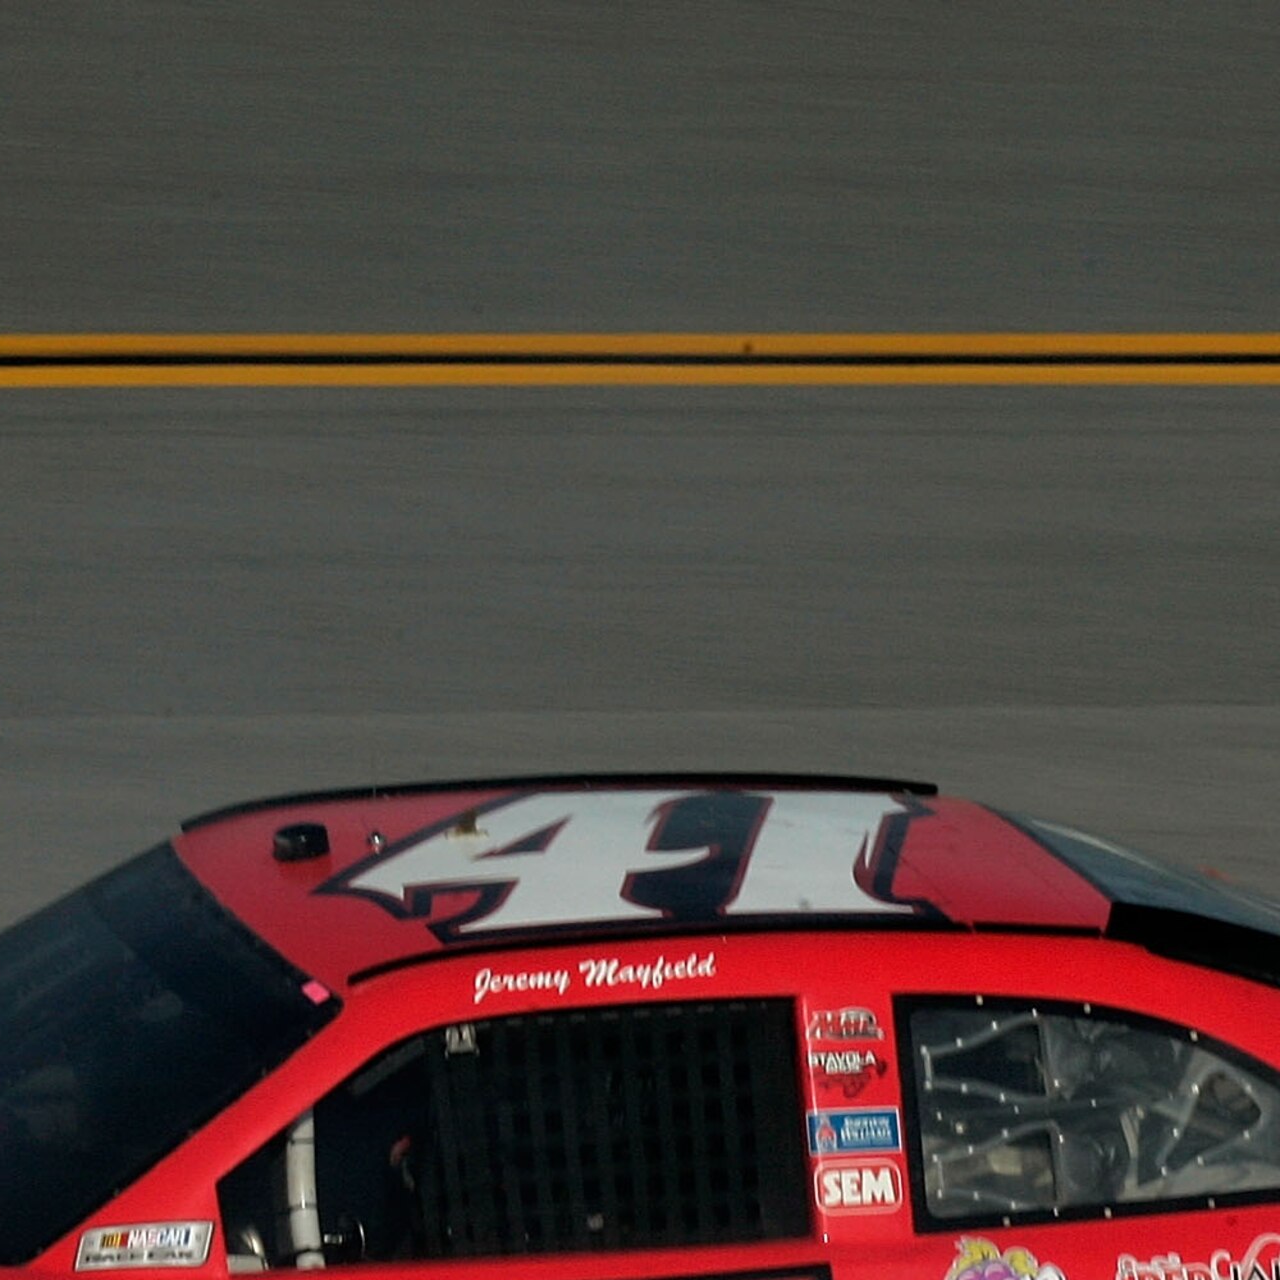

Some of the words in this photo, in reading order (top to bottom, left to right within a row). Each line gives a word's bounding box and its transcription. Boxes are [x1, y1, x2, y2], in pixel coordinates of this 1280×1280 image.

[338, 789, 925, 938] 41
[473, 966, 570, 1004] Jeremy
[578, 952, 717, 993] Mayfield
[822, 1167, 896, 1206] SEM
[126, 1228, 191, 1248] NASCAR
